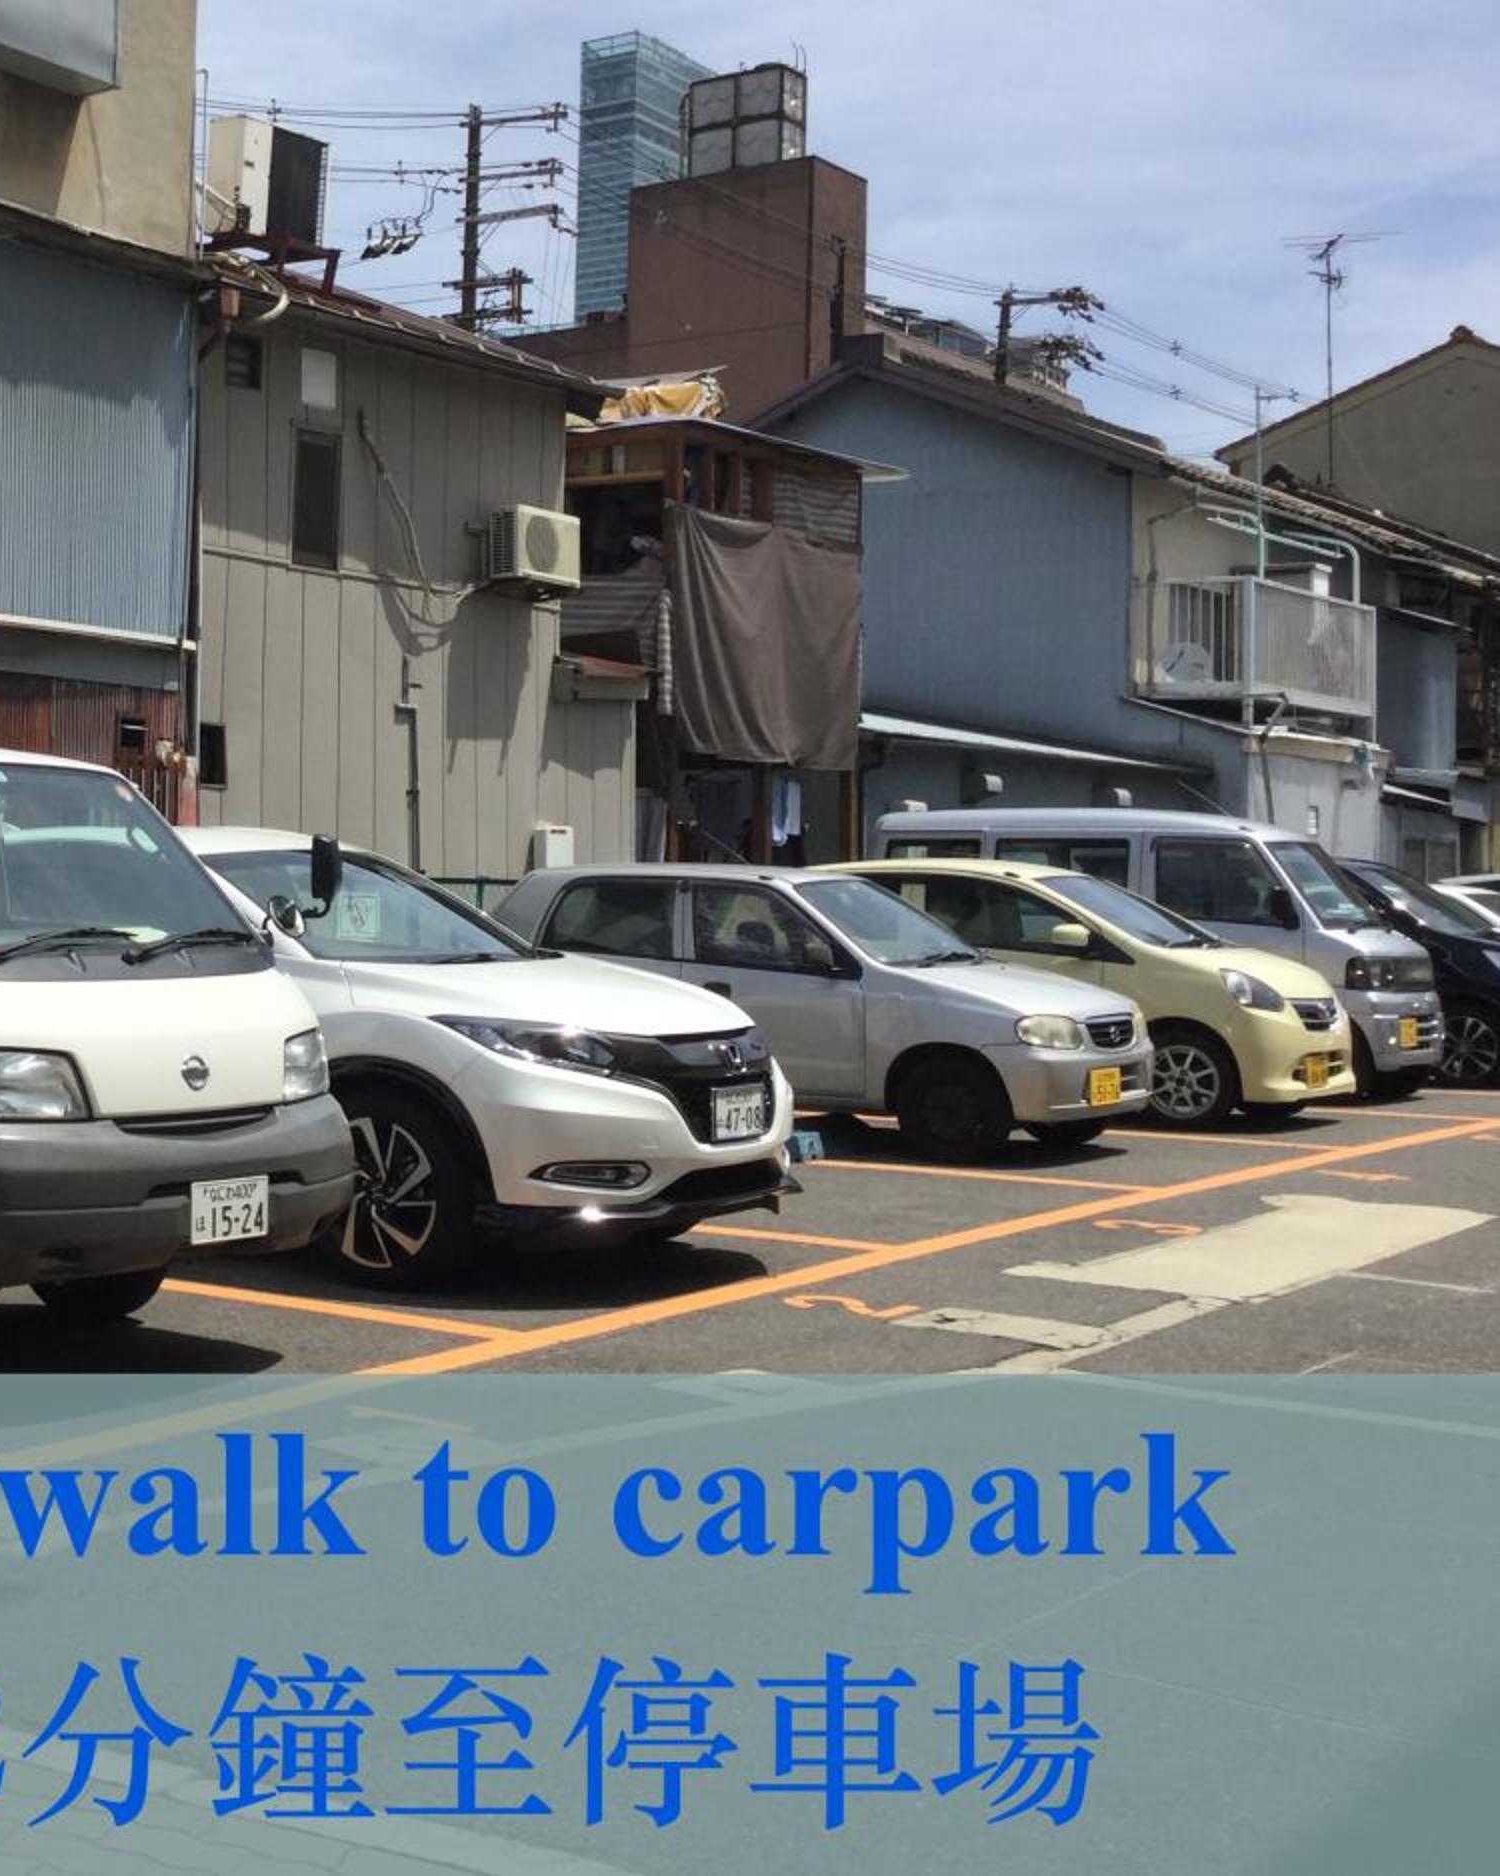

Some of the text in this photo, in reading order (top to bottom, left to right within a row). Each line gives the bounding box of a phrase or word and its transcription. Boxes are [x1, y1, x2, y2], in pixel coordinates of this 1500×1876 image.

[725, 1105, 761, 1131] 47-08
[211, 1201, 264, 1239] 15-24
[784, 1294, 921, 1321] 2
